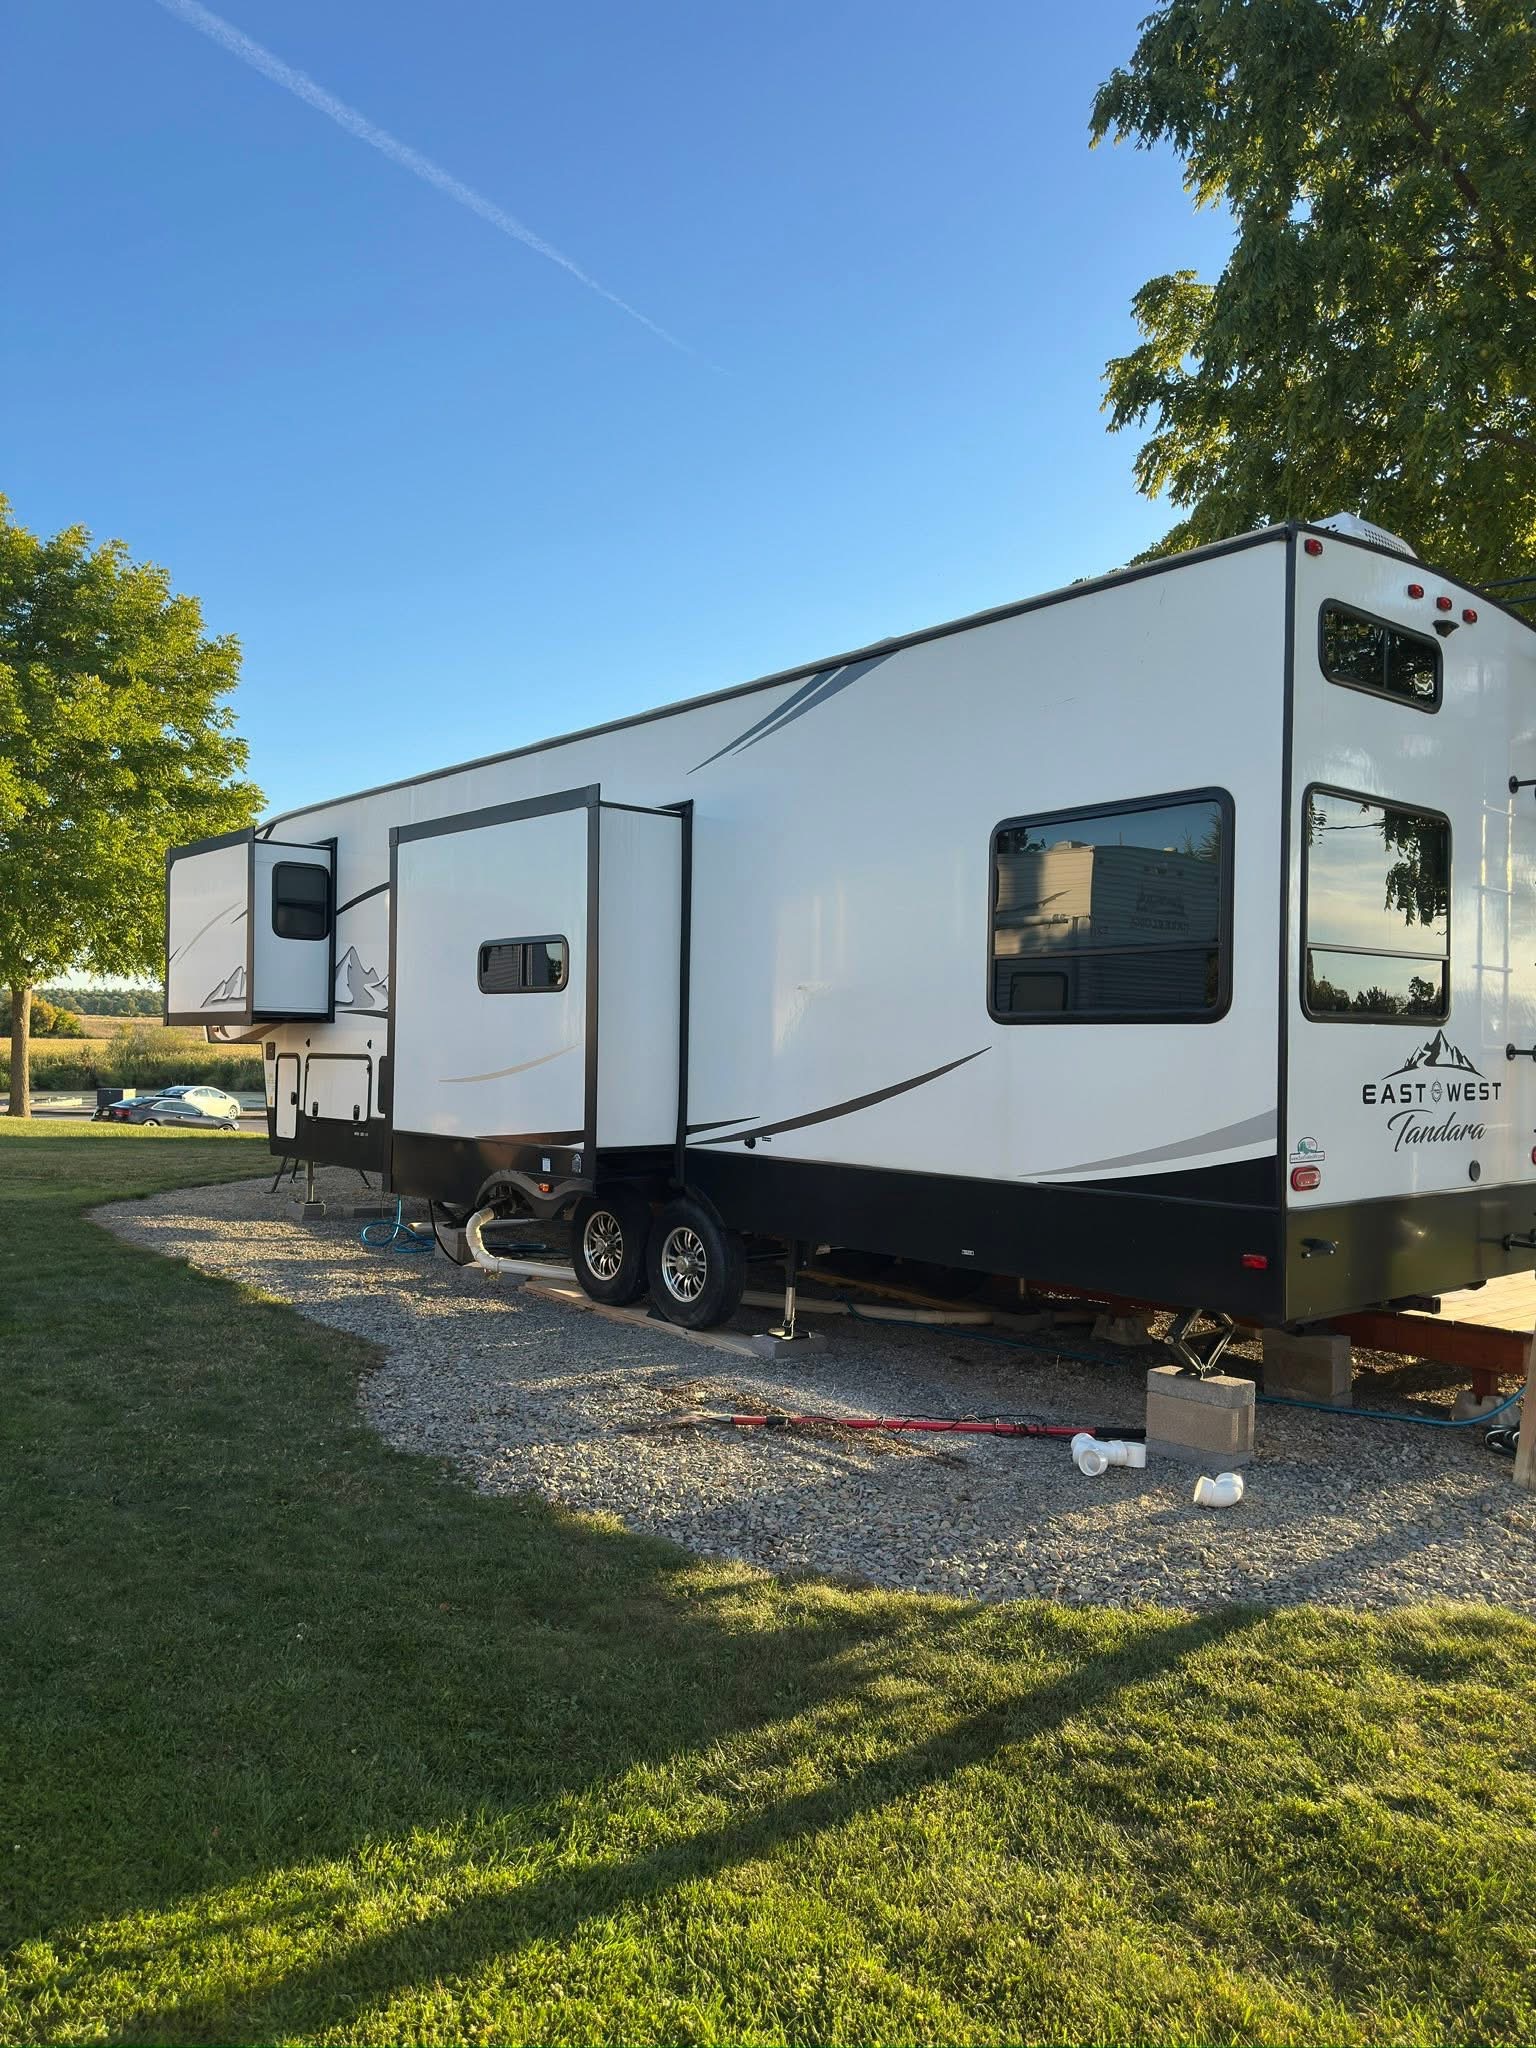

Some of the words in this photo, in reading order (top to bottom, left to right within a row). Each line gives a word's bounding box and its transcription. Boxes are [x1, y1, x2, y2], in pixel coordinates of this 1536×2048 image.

[1362, 1083, 1427, 1105] EAST
[1446, 1082, 1502, 1103] WEST
[1387, 1109, 1487, 1153] Tandara
